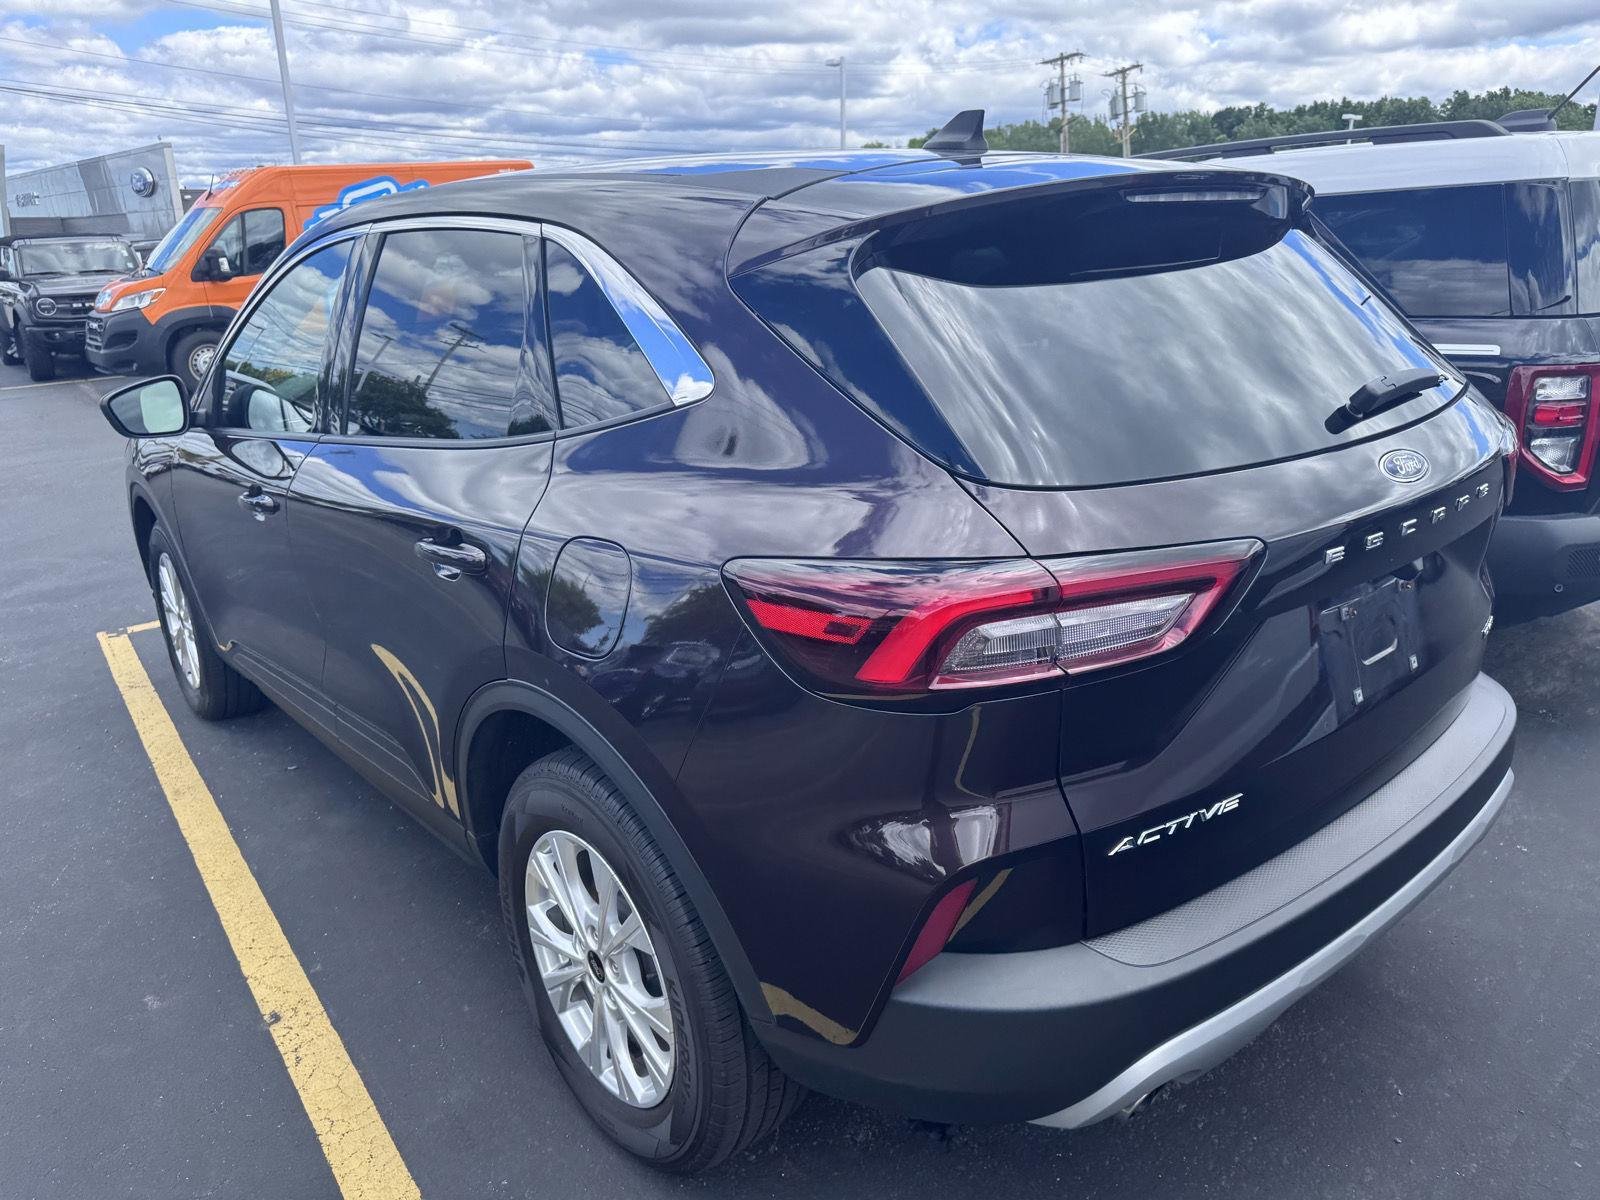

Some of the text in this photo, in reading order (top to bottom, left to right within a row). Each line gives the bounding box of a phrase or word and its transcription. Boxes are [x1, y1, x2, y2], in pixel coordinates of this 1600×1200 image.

[1393, 455, 1421, 474] Ford
[1324, 483, 1489, 564] ESCAPE
[1108, 792, 1243, 856] ACTIVE
